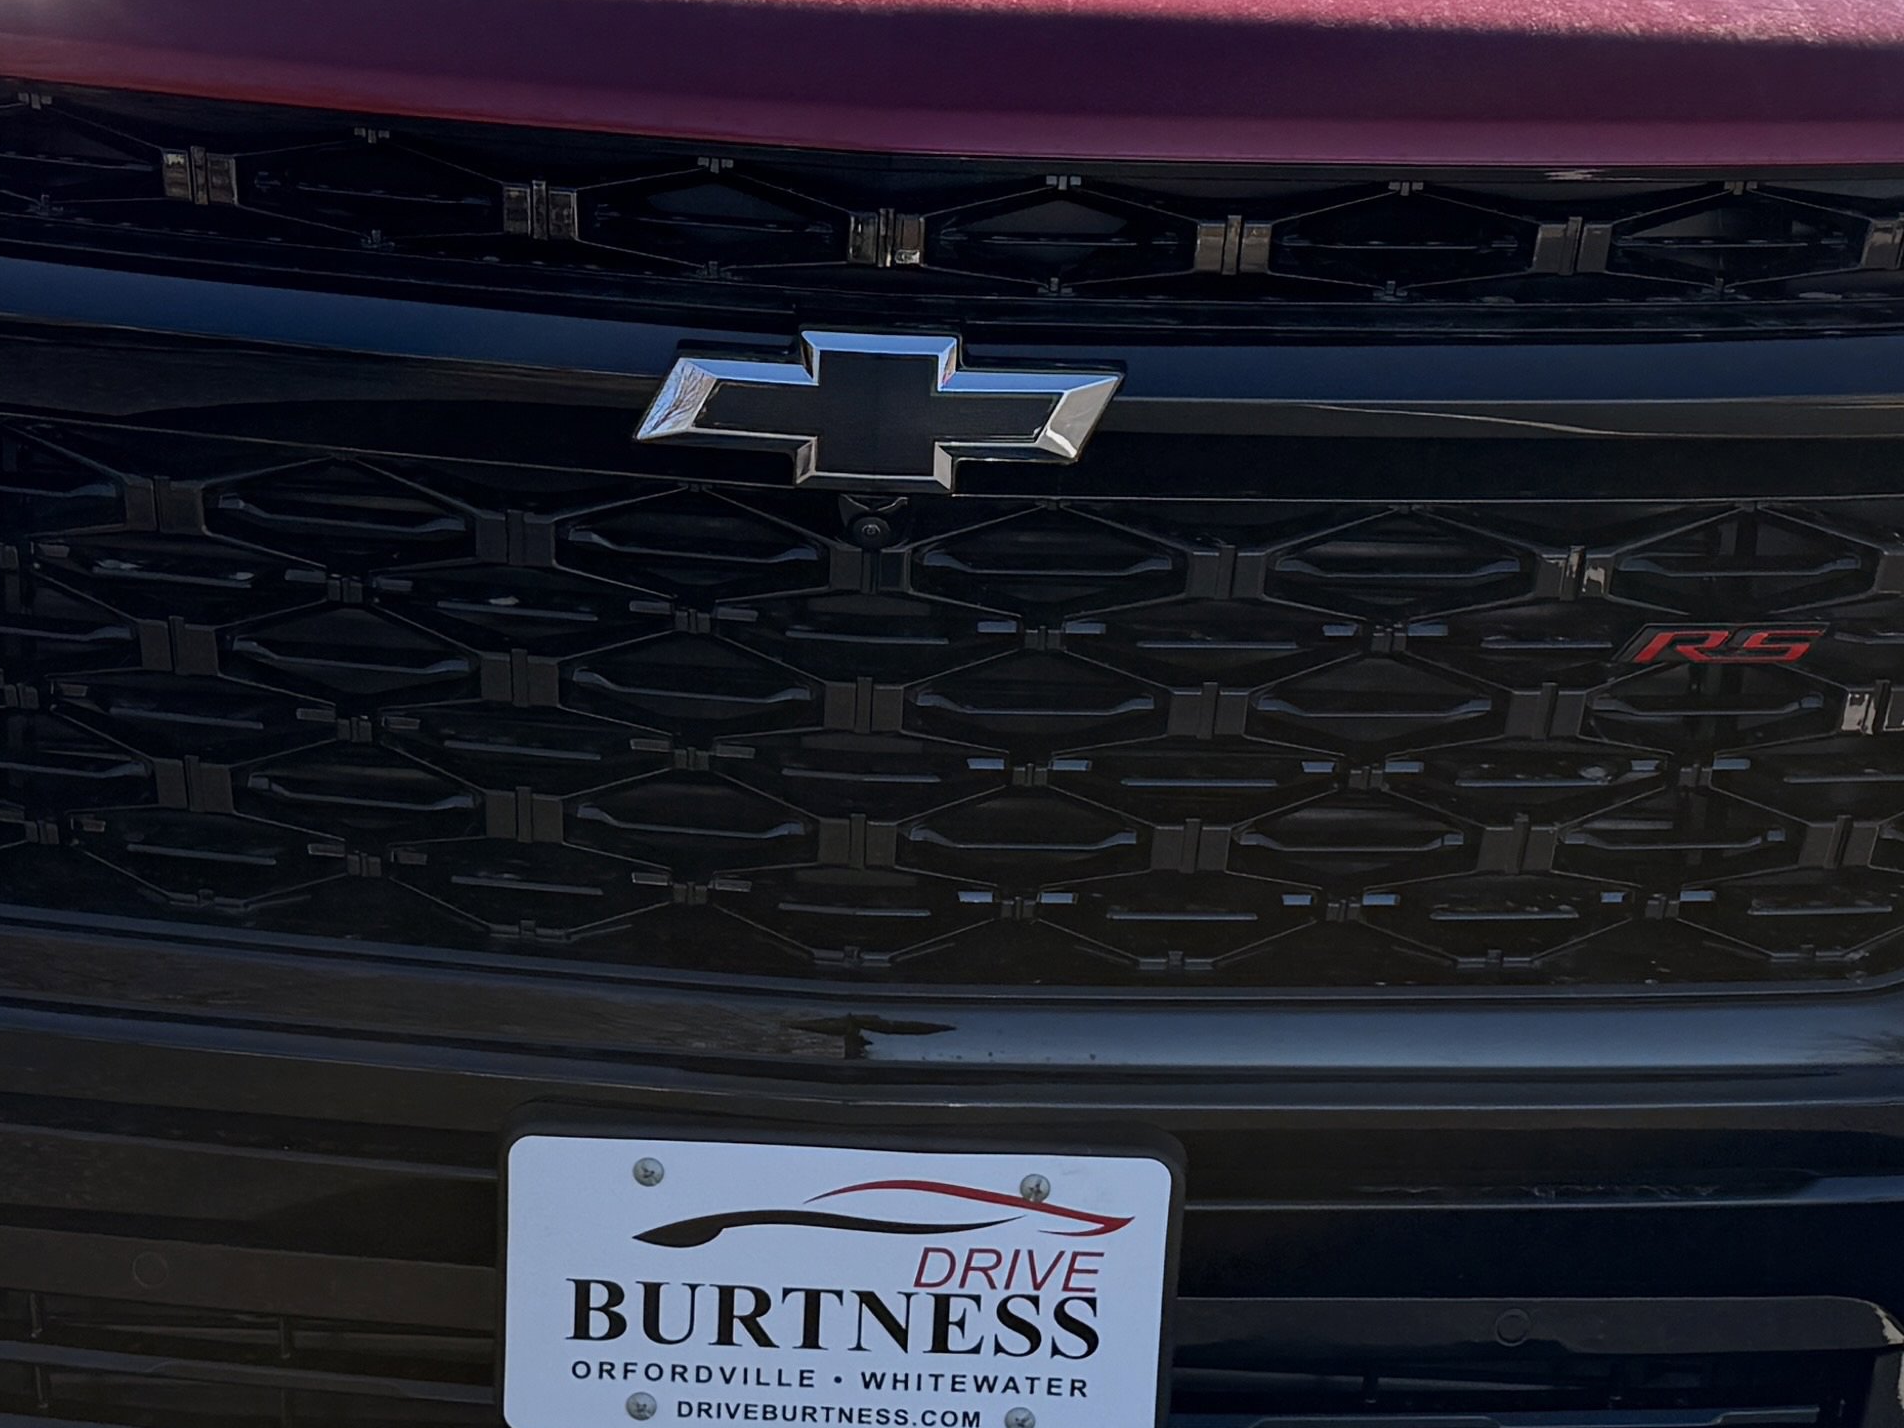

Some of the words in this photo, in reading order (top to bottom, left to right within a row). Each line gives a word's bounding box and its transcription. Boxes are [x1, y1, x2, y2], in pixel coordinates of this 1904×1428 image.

[1634, 630, 1825, 664] RS
[913, 1247, 1105, 1293] DRIVE
[565, 1278, 1100, 1360] BURTNESS
[571, 1360, 816, 1388] ORFORDVILLE
[860, 1371, 1088, 1398] WHITEWATER
[677, 1400, 981, 1428] DRIVEBURTNESS.COM
